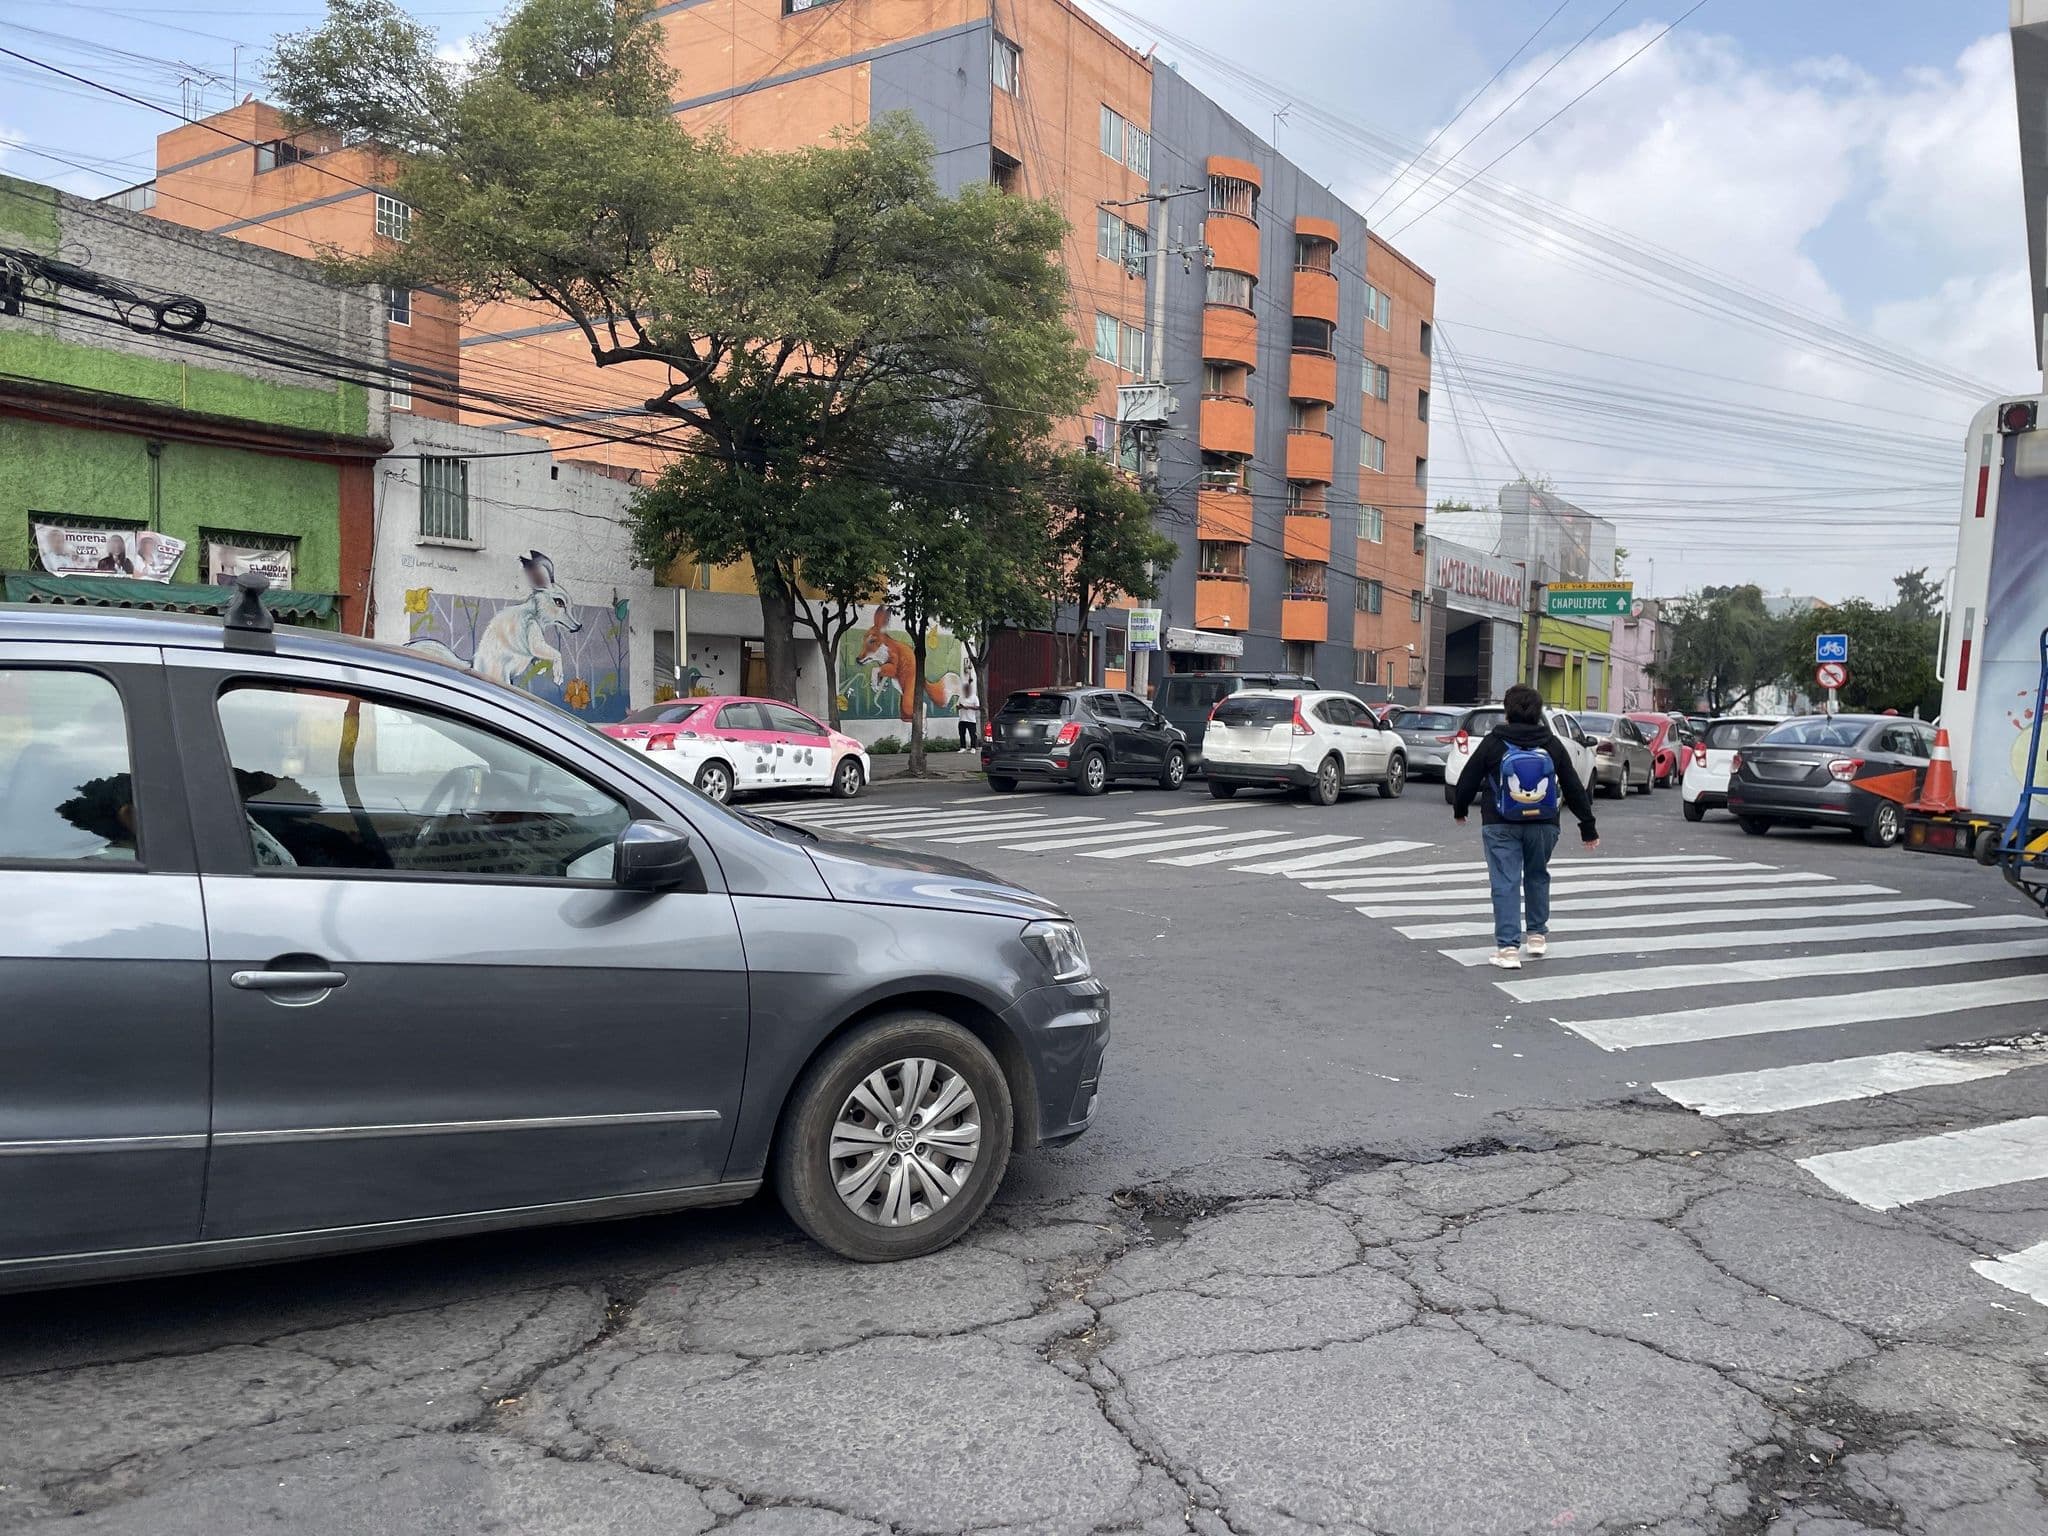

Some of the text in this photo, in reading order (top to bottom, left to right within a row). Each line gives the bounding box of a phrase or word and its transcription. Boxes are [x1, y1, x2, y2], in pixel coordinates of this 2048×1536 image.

[65, 533, 107, 543] morena
[249, 564, 287, 572] CLAUDIA
[1439, 555, 1469, 594] HOTEL
[1551, 597, 1608, 609] CHAPULTEPEC
